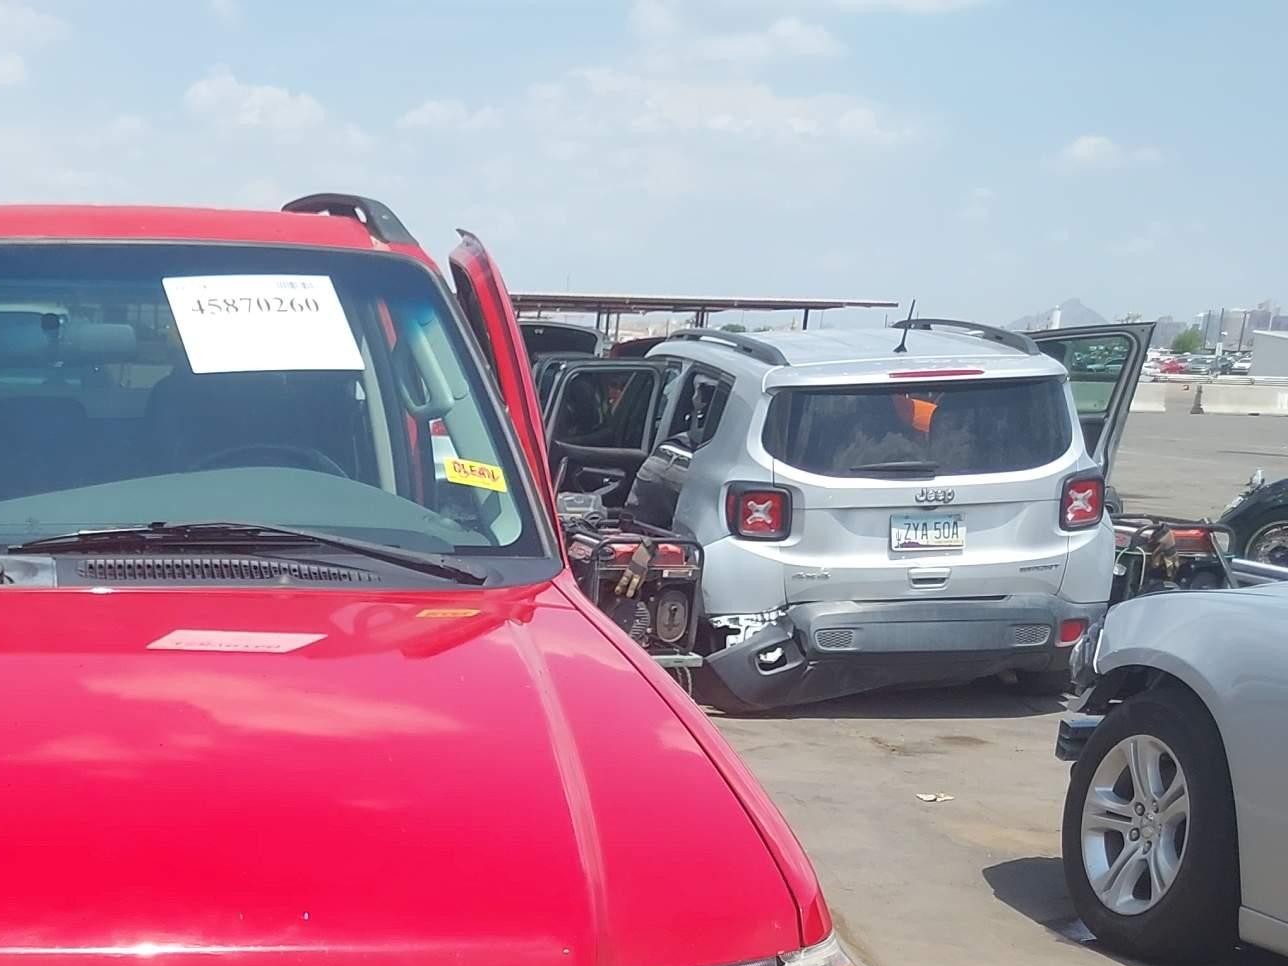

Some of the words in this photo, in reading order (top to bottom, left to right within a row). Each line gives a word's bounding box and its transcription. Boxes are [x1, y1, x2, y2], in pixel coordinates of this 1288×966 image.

[191, 297, 320, 315] 45870260
[915, 487, 955, 504] Jeep
[904, 522, 929, 540] ZYA
